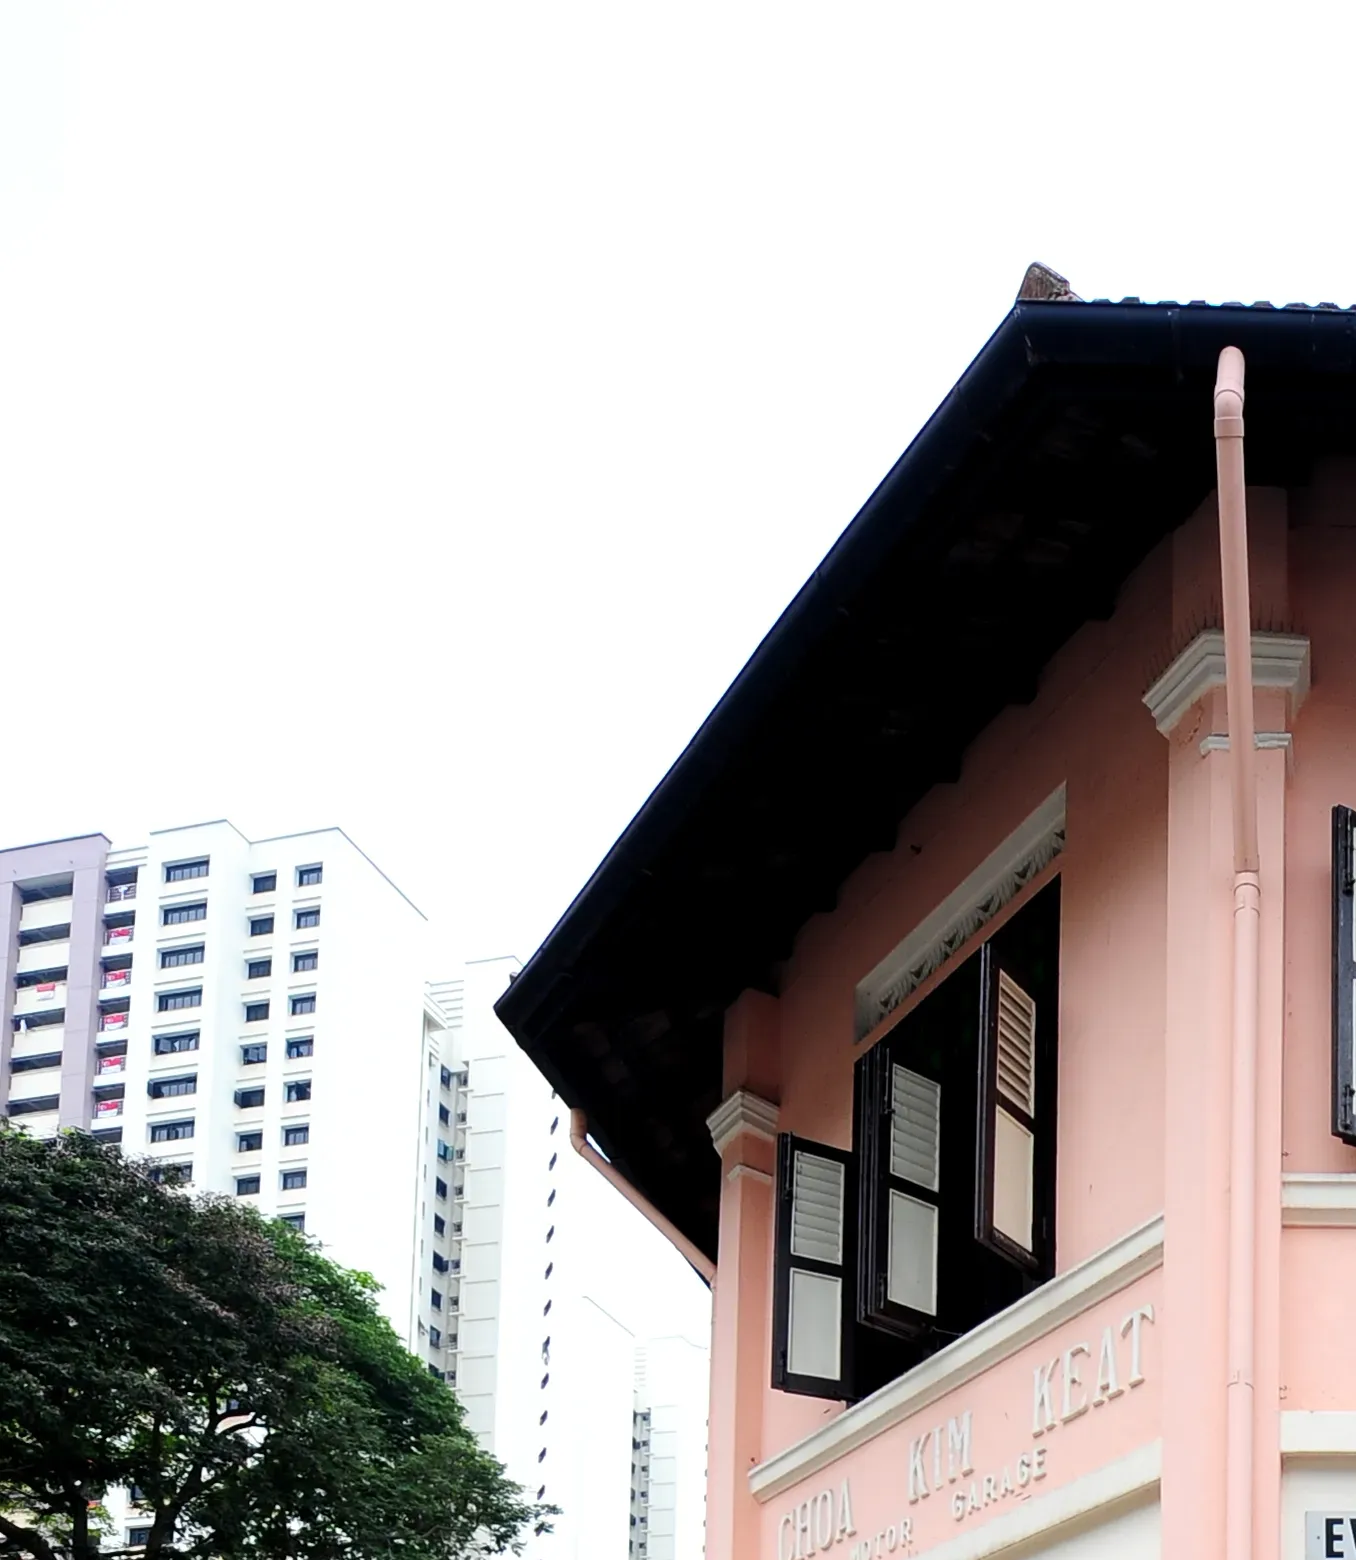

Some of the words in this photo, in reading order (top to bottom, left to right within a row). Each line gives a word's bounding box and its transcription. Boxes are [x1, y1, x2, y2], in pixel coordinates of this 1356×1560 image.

[909, 1411, 974, 1505] KIM
[1033, 1304, 1155, 1439] KEAT
[952, 1448, 1047, 1522] GARAGE
